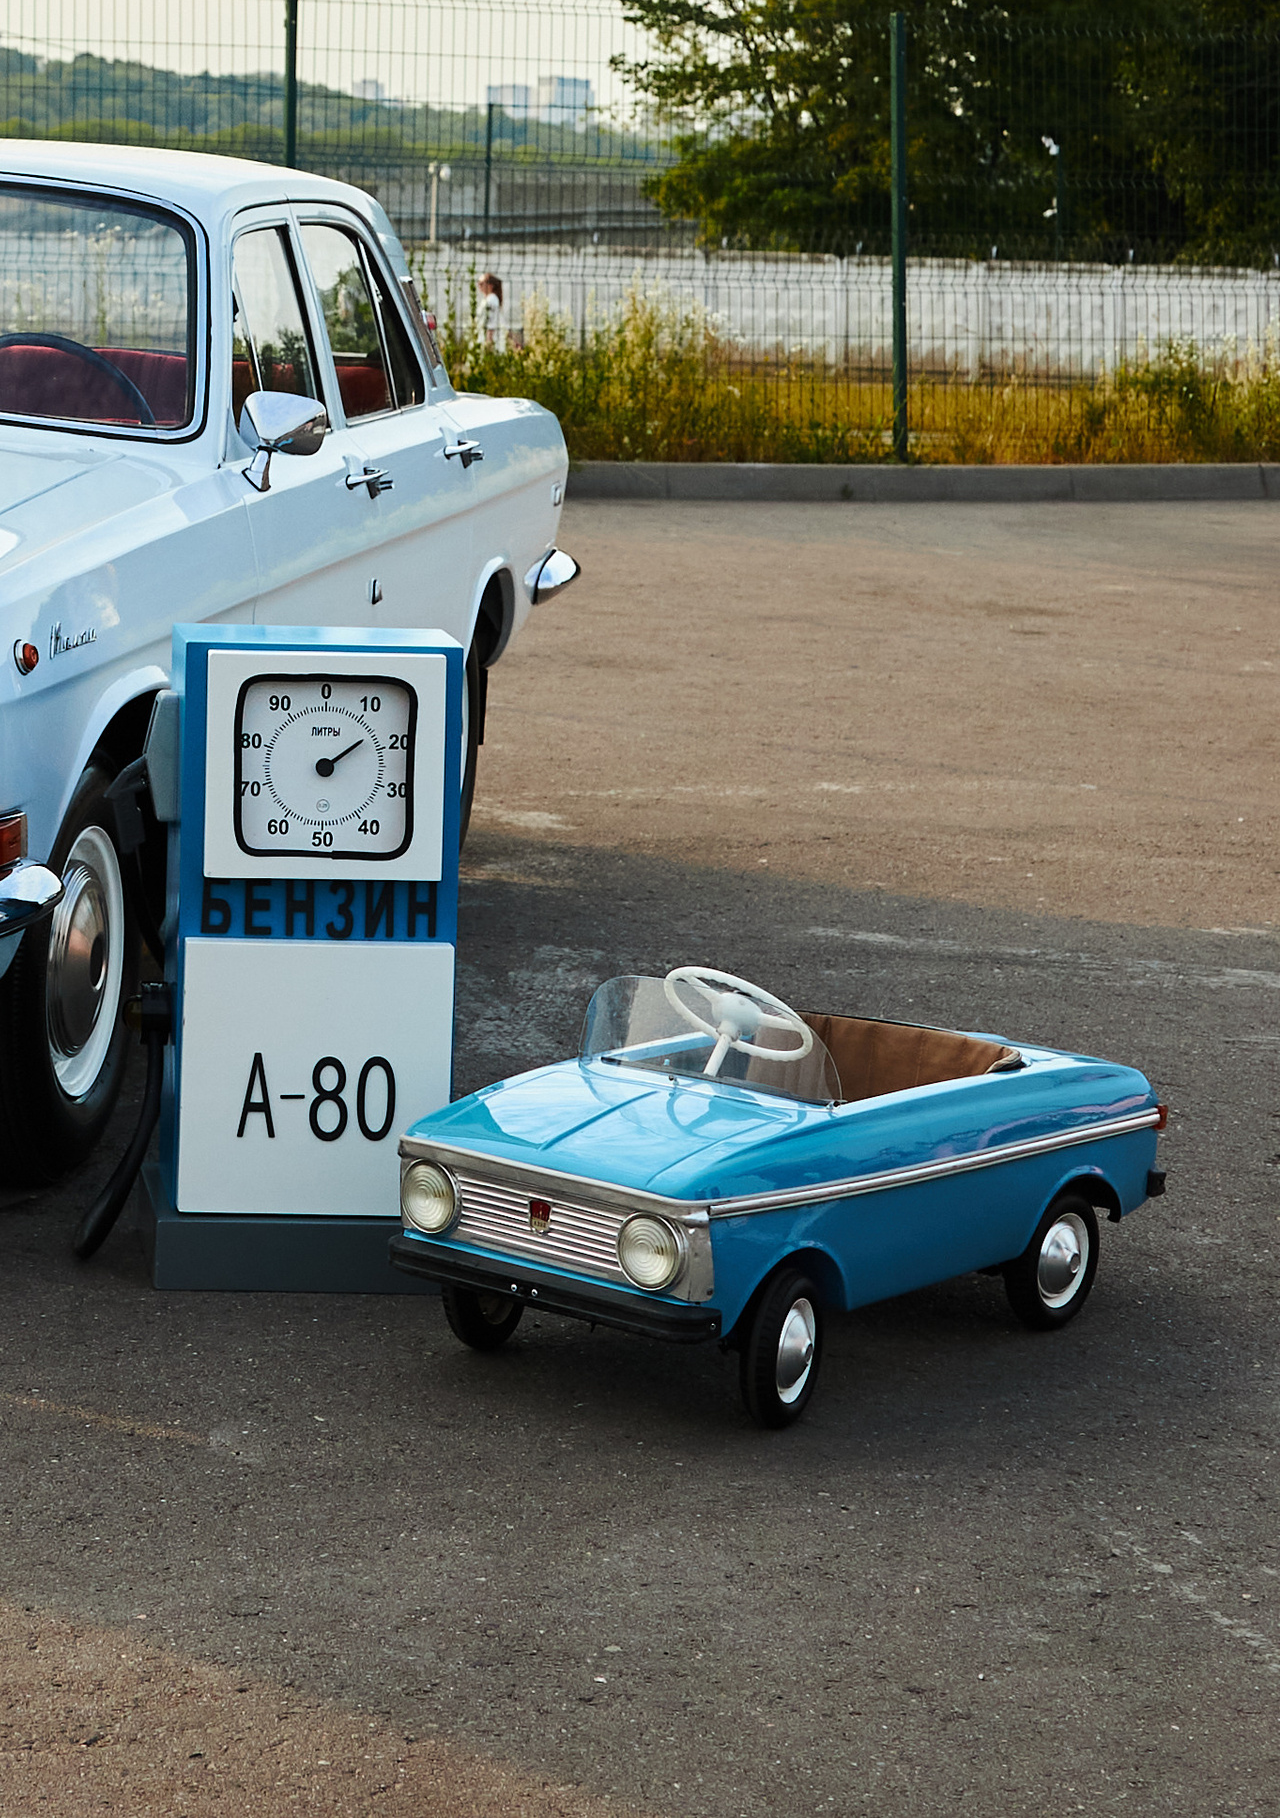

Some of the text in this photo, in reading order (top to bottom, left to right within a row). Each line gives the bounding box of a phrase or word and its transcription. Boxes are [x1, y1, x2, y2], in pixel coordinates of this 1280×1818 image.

[320, 683, 332, 699] 0
[268, 694, 291, 712] 90
[359, 696, 381, 713] 10
[311, 726, 341, 737] ЛИТРЫ
[241, 733, 262, 749] 80
[389, 734, 409, 750] 20
[241, 781, 261, 797] 70
[387, 782, 407, 798] 30
[267, 819, 290, 835] 60
[358, 819, 380, 835] 40
[311, 832, 334, 847] 50
[200, 878, 437, 939] БЕНЗИН
[237, 1053, 396, 1142] А-80
